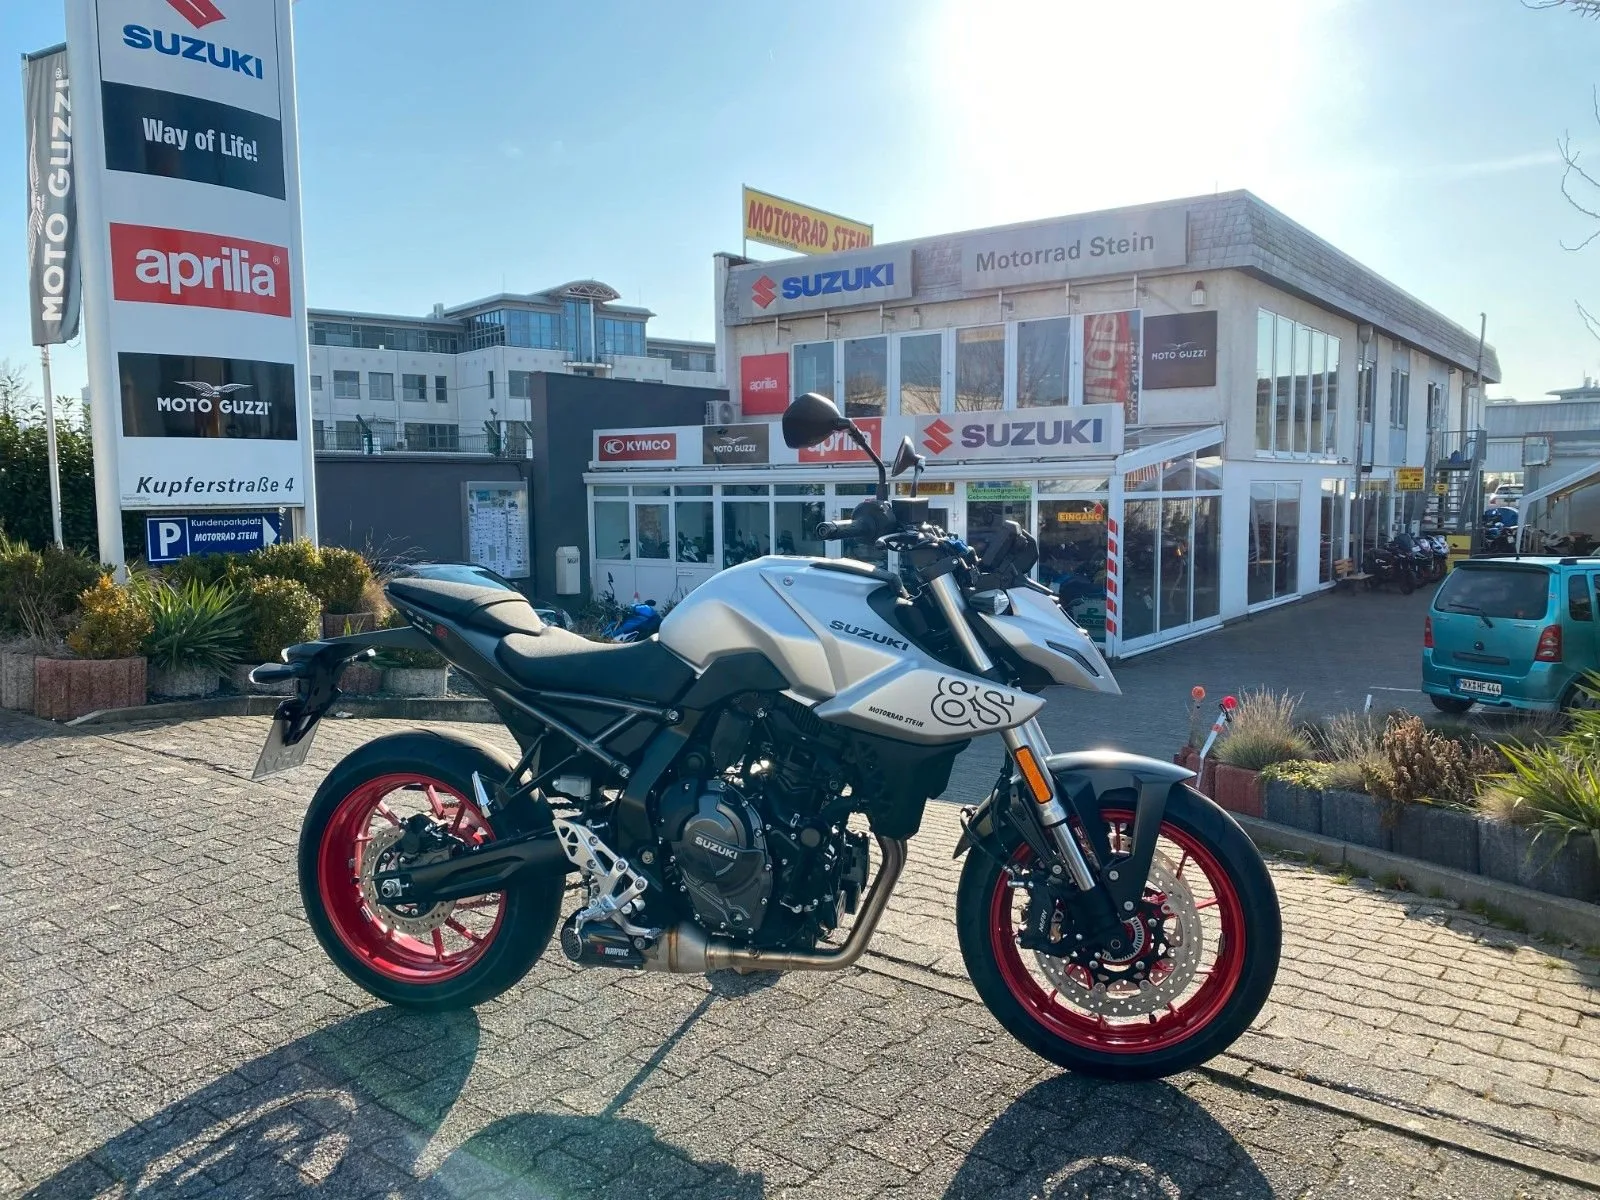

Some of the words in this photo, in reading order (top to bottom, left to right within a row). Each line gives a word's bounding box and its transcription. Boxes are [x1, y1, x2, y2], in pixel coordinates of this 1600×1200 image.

[123, 24, 263, 80] SUZUKI
[48, 79, 72, 198] GUZZI
[142, 117, 188, 151] Way
[195, 129, 215, 152] of
[221, 132, 258, 162] Life!
[748, 199, 829, 249] MOTORRAD
[976, 239, 1081, 273] Motorrad
[1090, 232, 1154, 257] Stein
[42, 213, 68, 321] MOTO
[135, 247, 276, 297] aprilia
[782, 262, 894, 299] SUZUKI
[1151, 350, 1177, 361] MOTO
[1179, 348, 1207, 358] GUZZI
[749, 377, 778, 391] aprilia
[156, 397, 213, 413] MOTO
[219, 399, 269, 416] GUZZI
[626, 439, 671, 452] KYMCO
[961, 418, 1103, 449] SUZUKI
[713, 444, 733, 453] MOTO
[735, 443, 757, 453] GUZZI
[136, 475, 280, 498] Kupferstraße
[285, 477, 294, 492] 4
[191, 517, 262, 528] Kundenparkplatz
[1060, 512, 1102, 521] EINGANG
[159, 522, 182, 557] P
[194, 532, 236, 542] MOTORRAD
[237, 531, 259, 541] STEIN
[829, 619, 909, 651] SUZUKI
[1487, 684, 1501, 693] 444
[868, 706, 904, 721] MOTORRAD
[904, 717, 925, 728] STEIN
[694, 836, 739, 860] SUZUKI
